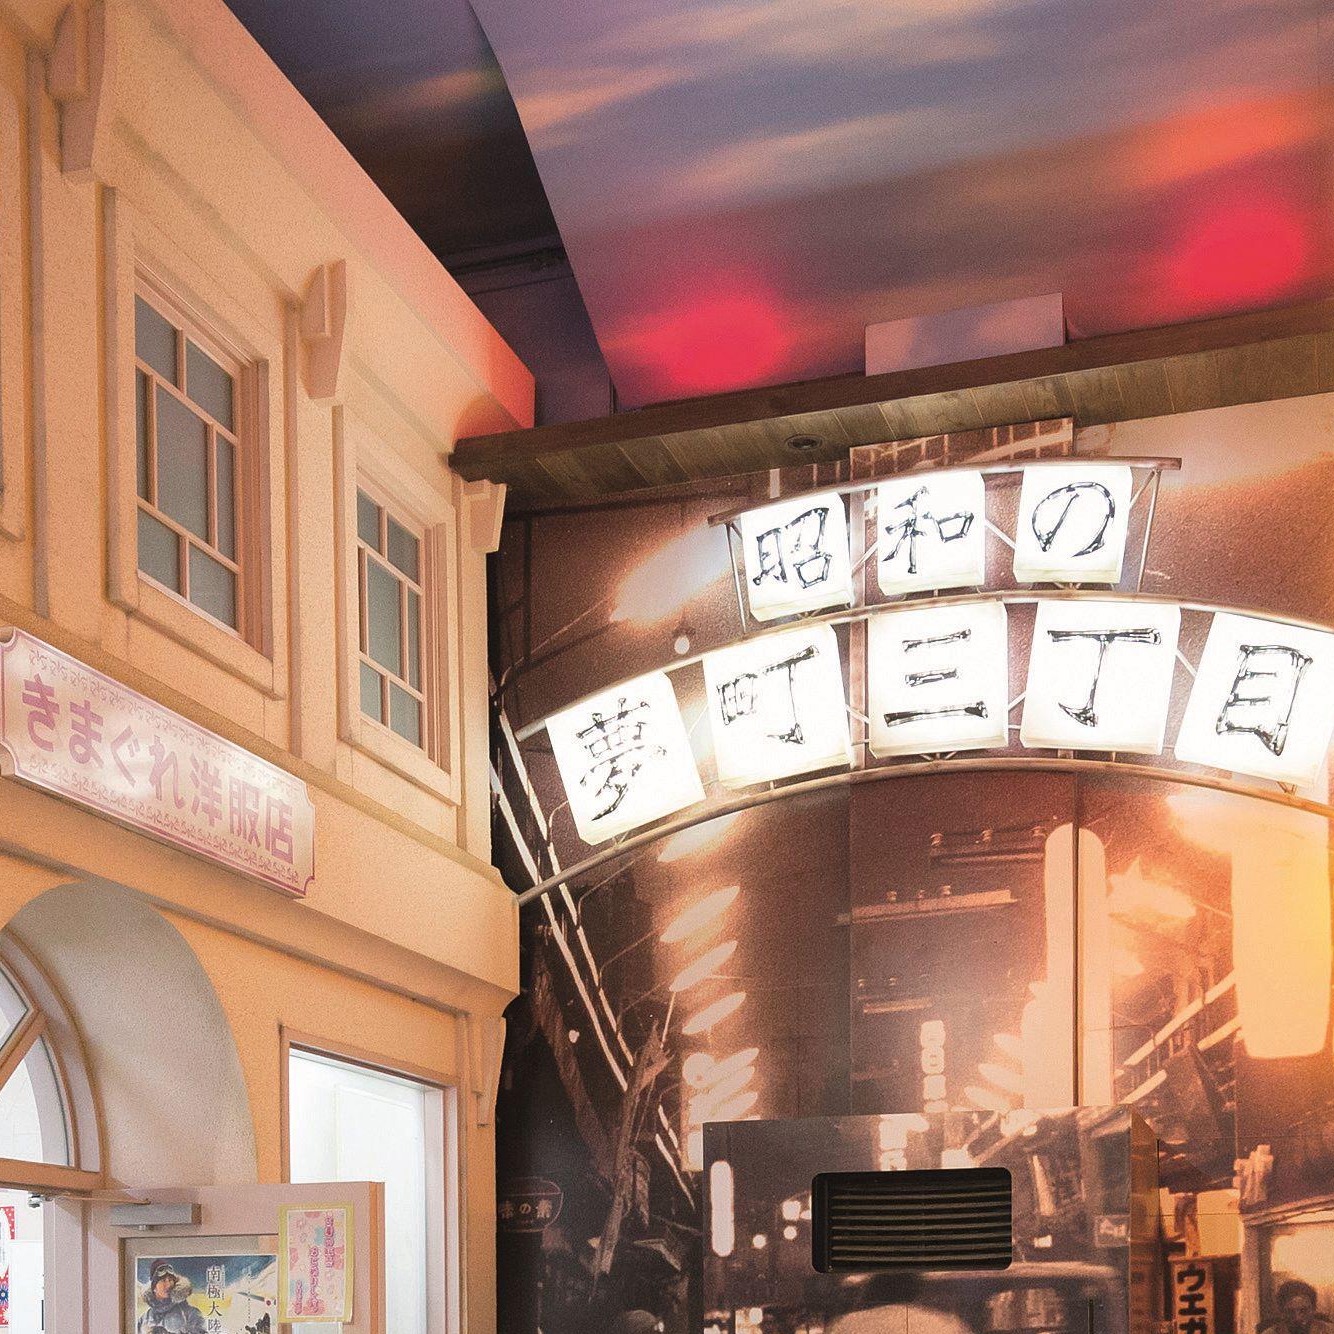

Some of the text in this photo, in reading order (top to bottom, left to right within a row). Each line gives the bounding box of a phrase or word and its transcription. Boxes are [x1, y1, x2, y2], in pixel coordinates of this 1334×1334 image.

[751, 480, 1117, 590] 昭和の
[22, 672, 294, 865] きまぐれ洋服店
[579, 627, 1312, 822] 夢町三丁目
[205, 1264, 223, 1334] 南極大陸
